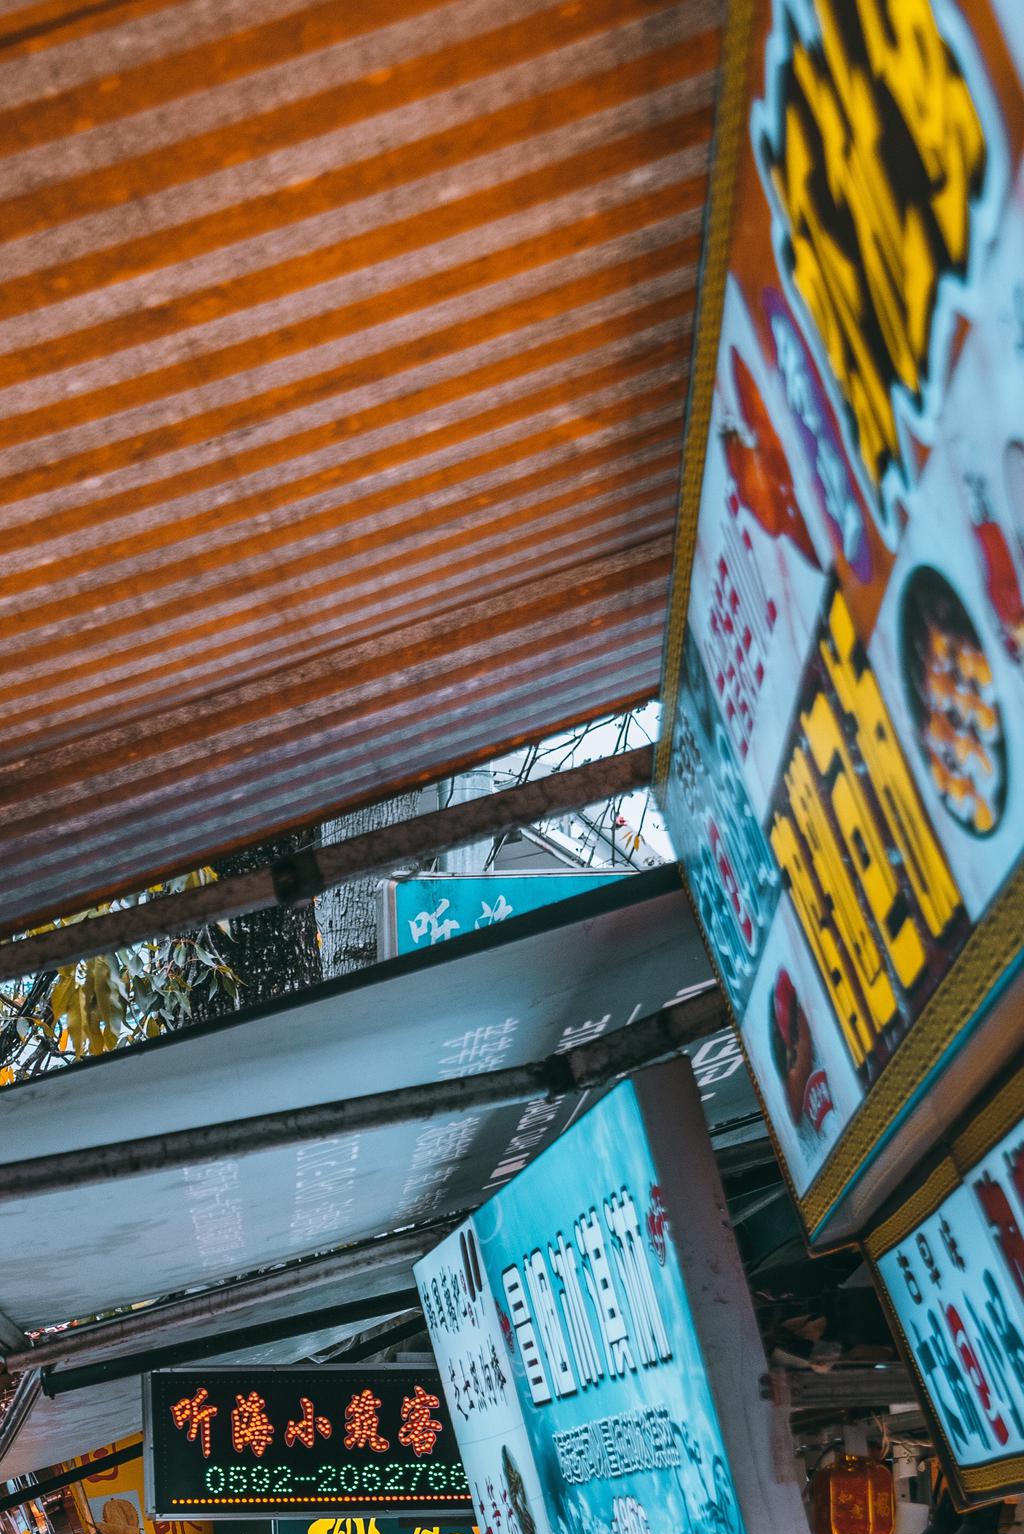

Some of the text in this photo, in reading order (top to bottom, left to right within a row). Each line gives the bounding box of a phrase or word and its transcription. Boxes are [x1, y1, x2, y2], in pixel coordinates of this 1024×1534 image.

[501, 1184, 673, 1408] 冒烟冰淇淋
